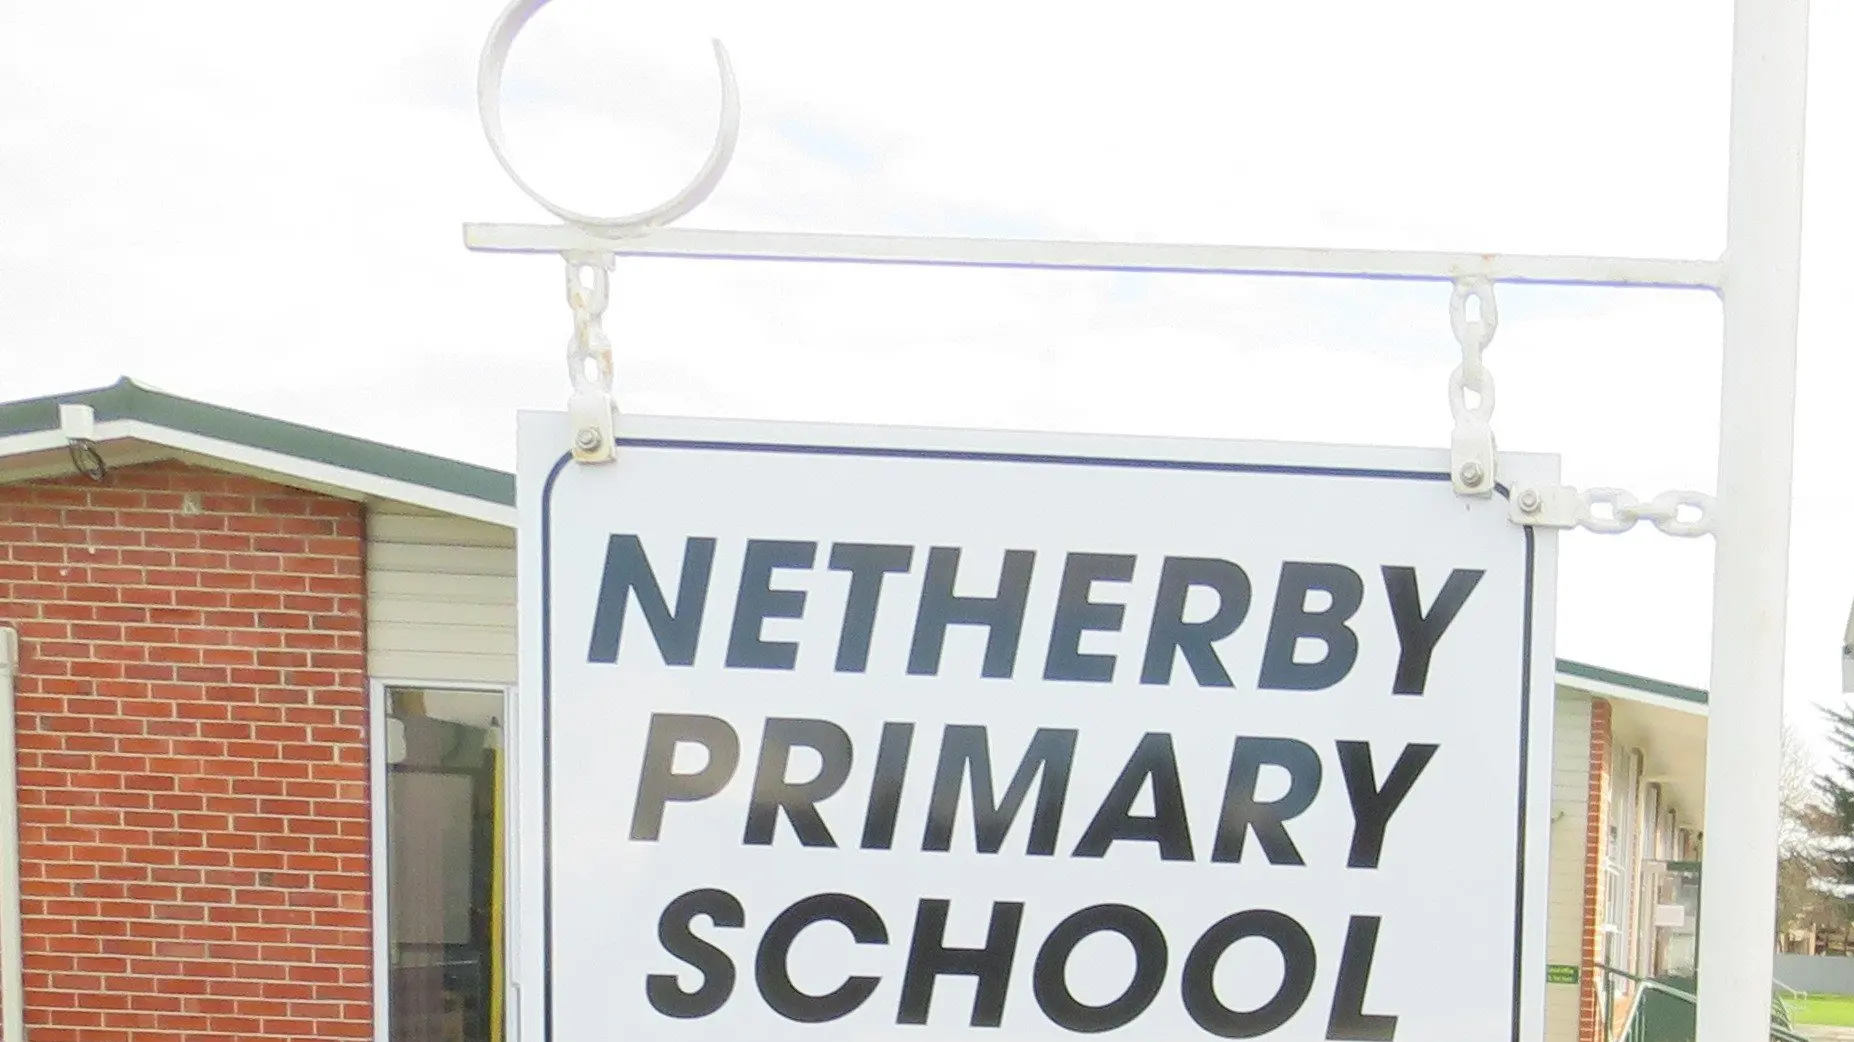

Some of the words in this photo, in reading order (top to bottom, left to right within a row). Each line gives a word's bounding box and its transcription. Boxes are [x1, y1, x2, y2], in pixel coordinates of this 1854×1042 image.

[587, 533, 1485, 696] NETHERBY
[629, 712, 1440, 869] PRIMARY
[645, 887, 1399, 1042] SCHOOL
